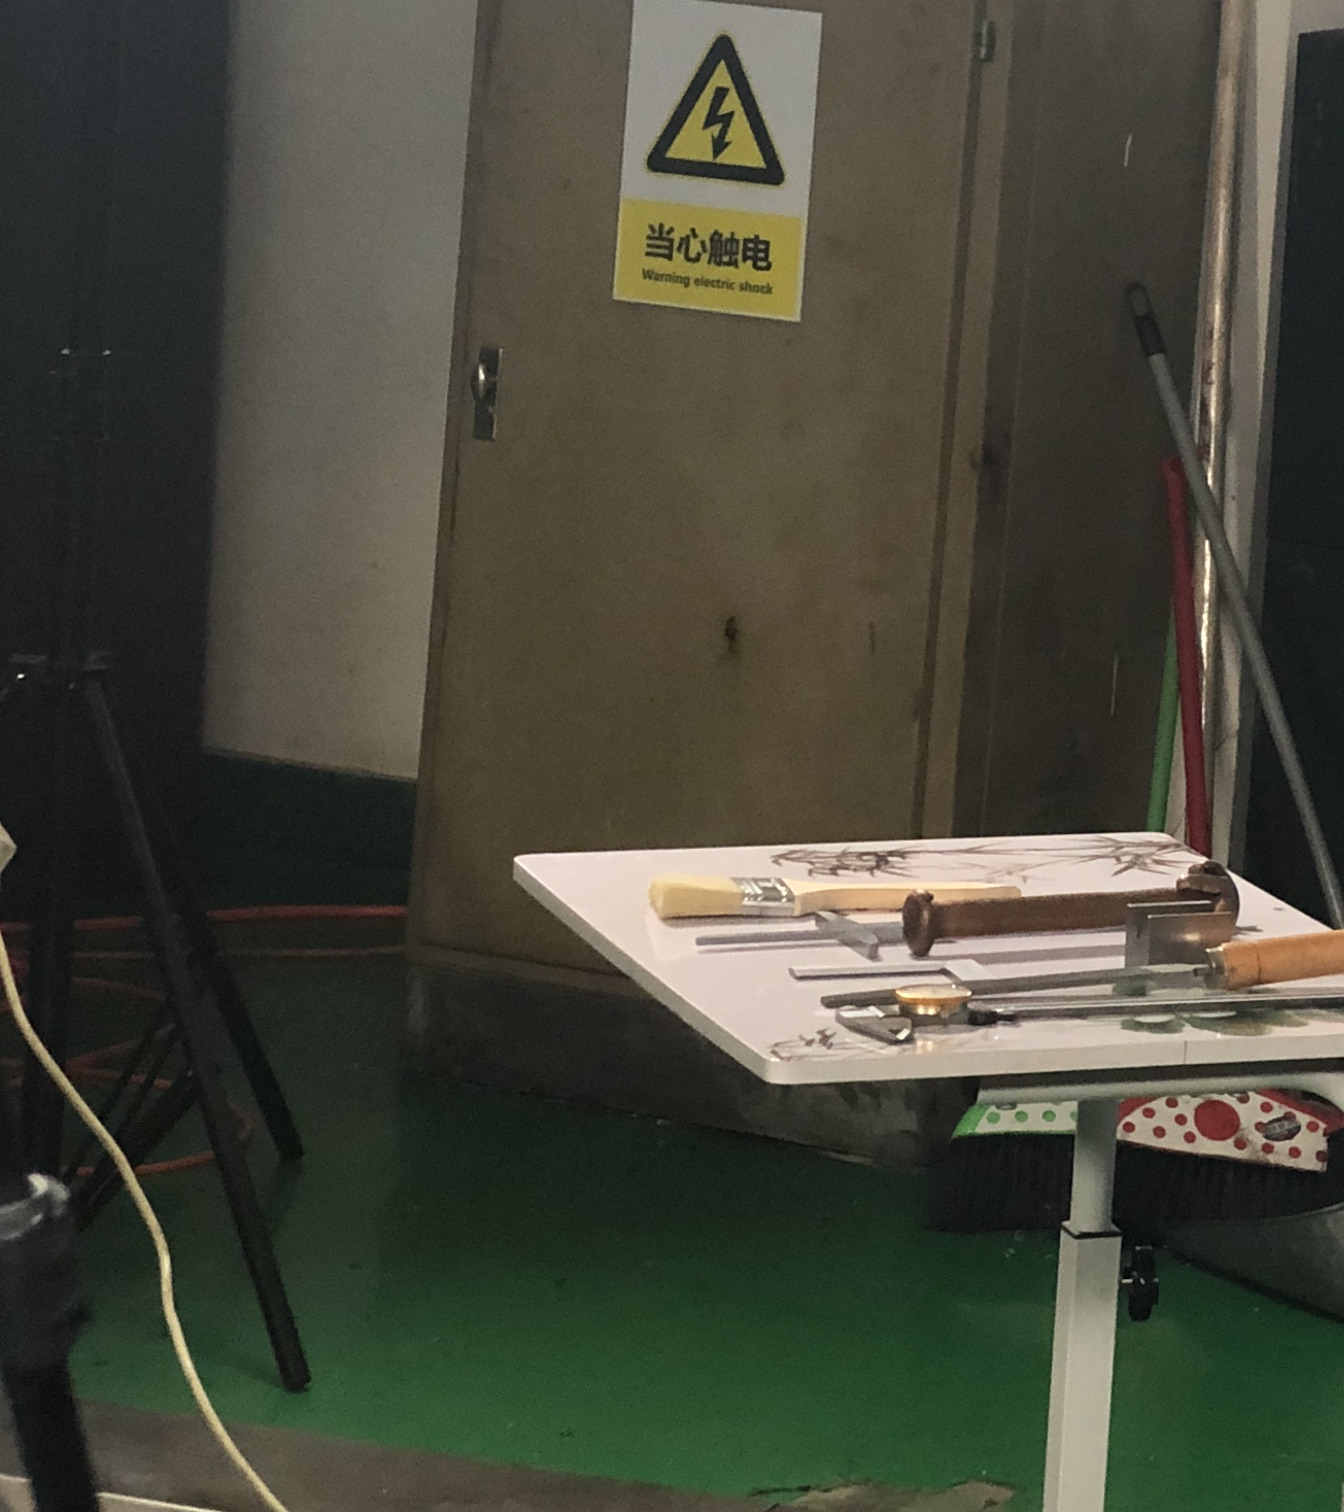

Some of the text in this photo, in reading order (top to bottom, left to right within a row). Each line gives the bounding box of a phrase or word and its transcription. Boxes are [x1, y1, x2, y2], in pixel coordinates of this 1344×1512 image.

[645, 223, 772, 271] 当心触电
[641, 268, 774, 296] Warning electric shock
